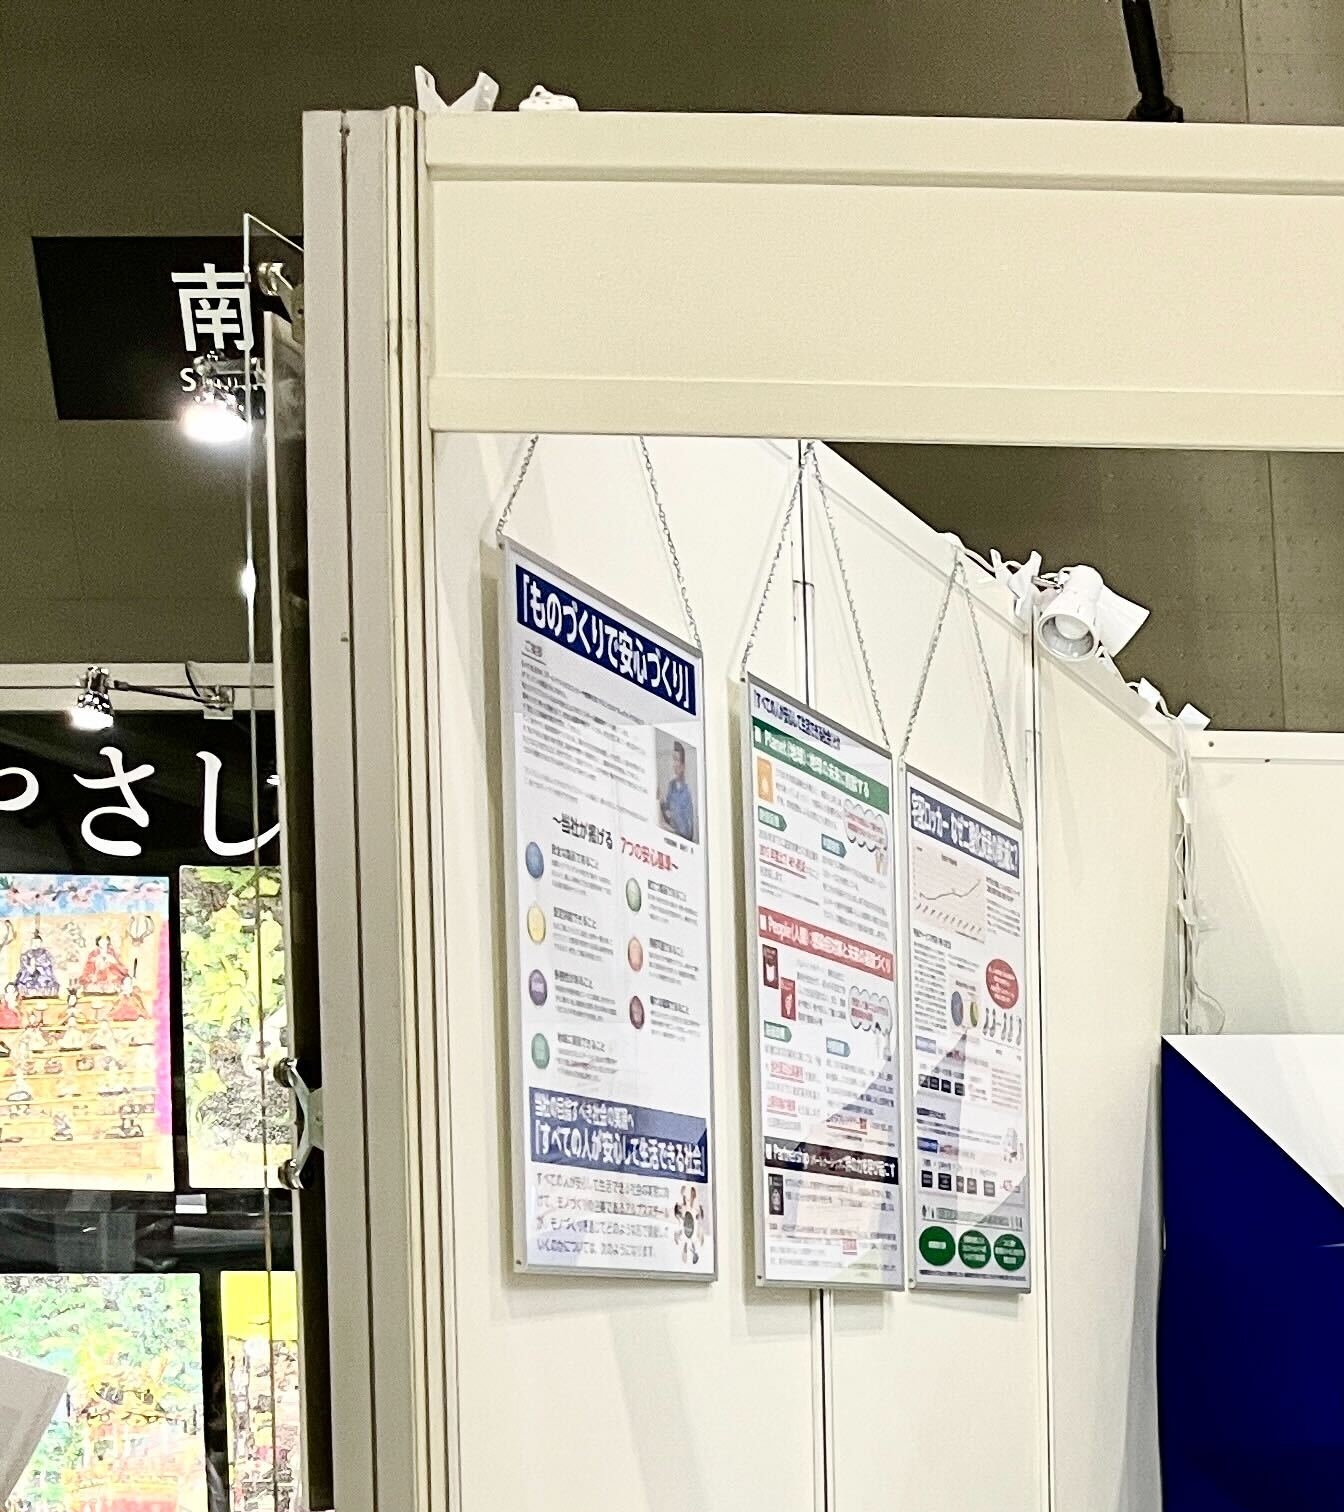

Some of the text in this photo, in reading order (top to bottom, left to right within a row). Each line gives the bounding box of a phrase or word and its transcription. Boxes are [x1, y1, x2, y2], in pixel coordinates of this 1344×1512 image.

[522, 573, 689, 709] 「ものづくりで安心づくり」
